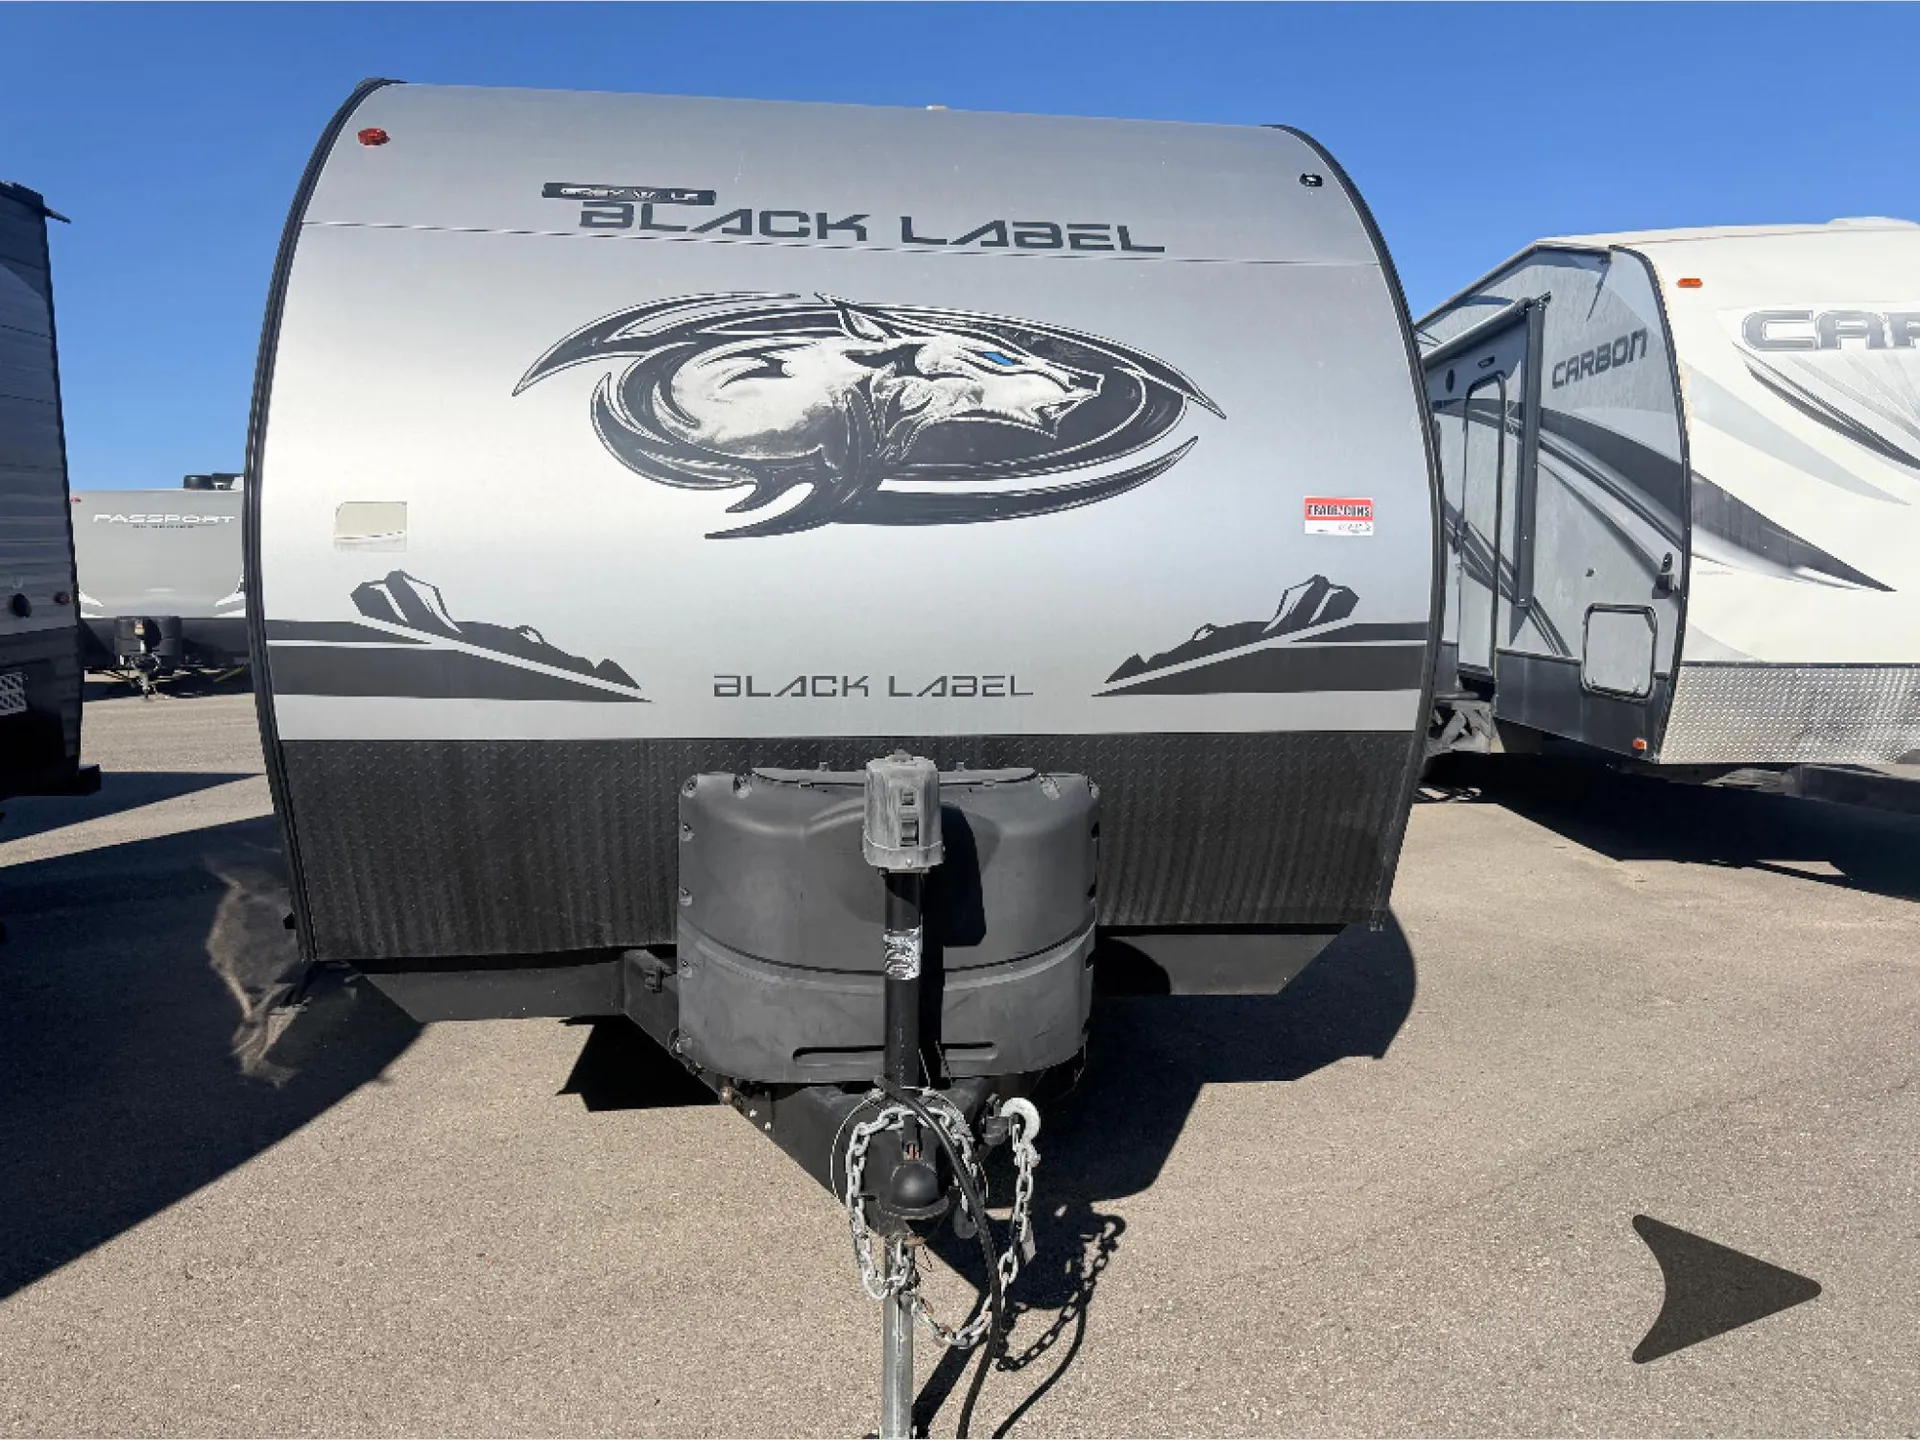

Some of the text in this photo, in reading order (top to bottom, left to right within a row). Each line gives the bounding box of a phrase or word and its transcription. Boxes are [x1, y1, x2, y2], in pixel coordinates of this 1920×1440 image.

[579, 200, 1165, 252] BLACK LABEL
[1552, 327, 1648, 389] CARBON
[93, 513, 235, 523] PASSPORT
[713, 675, 1034, 697] BLACK LABEL
